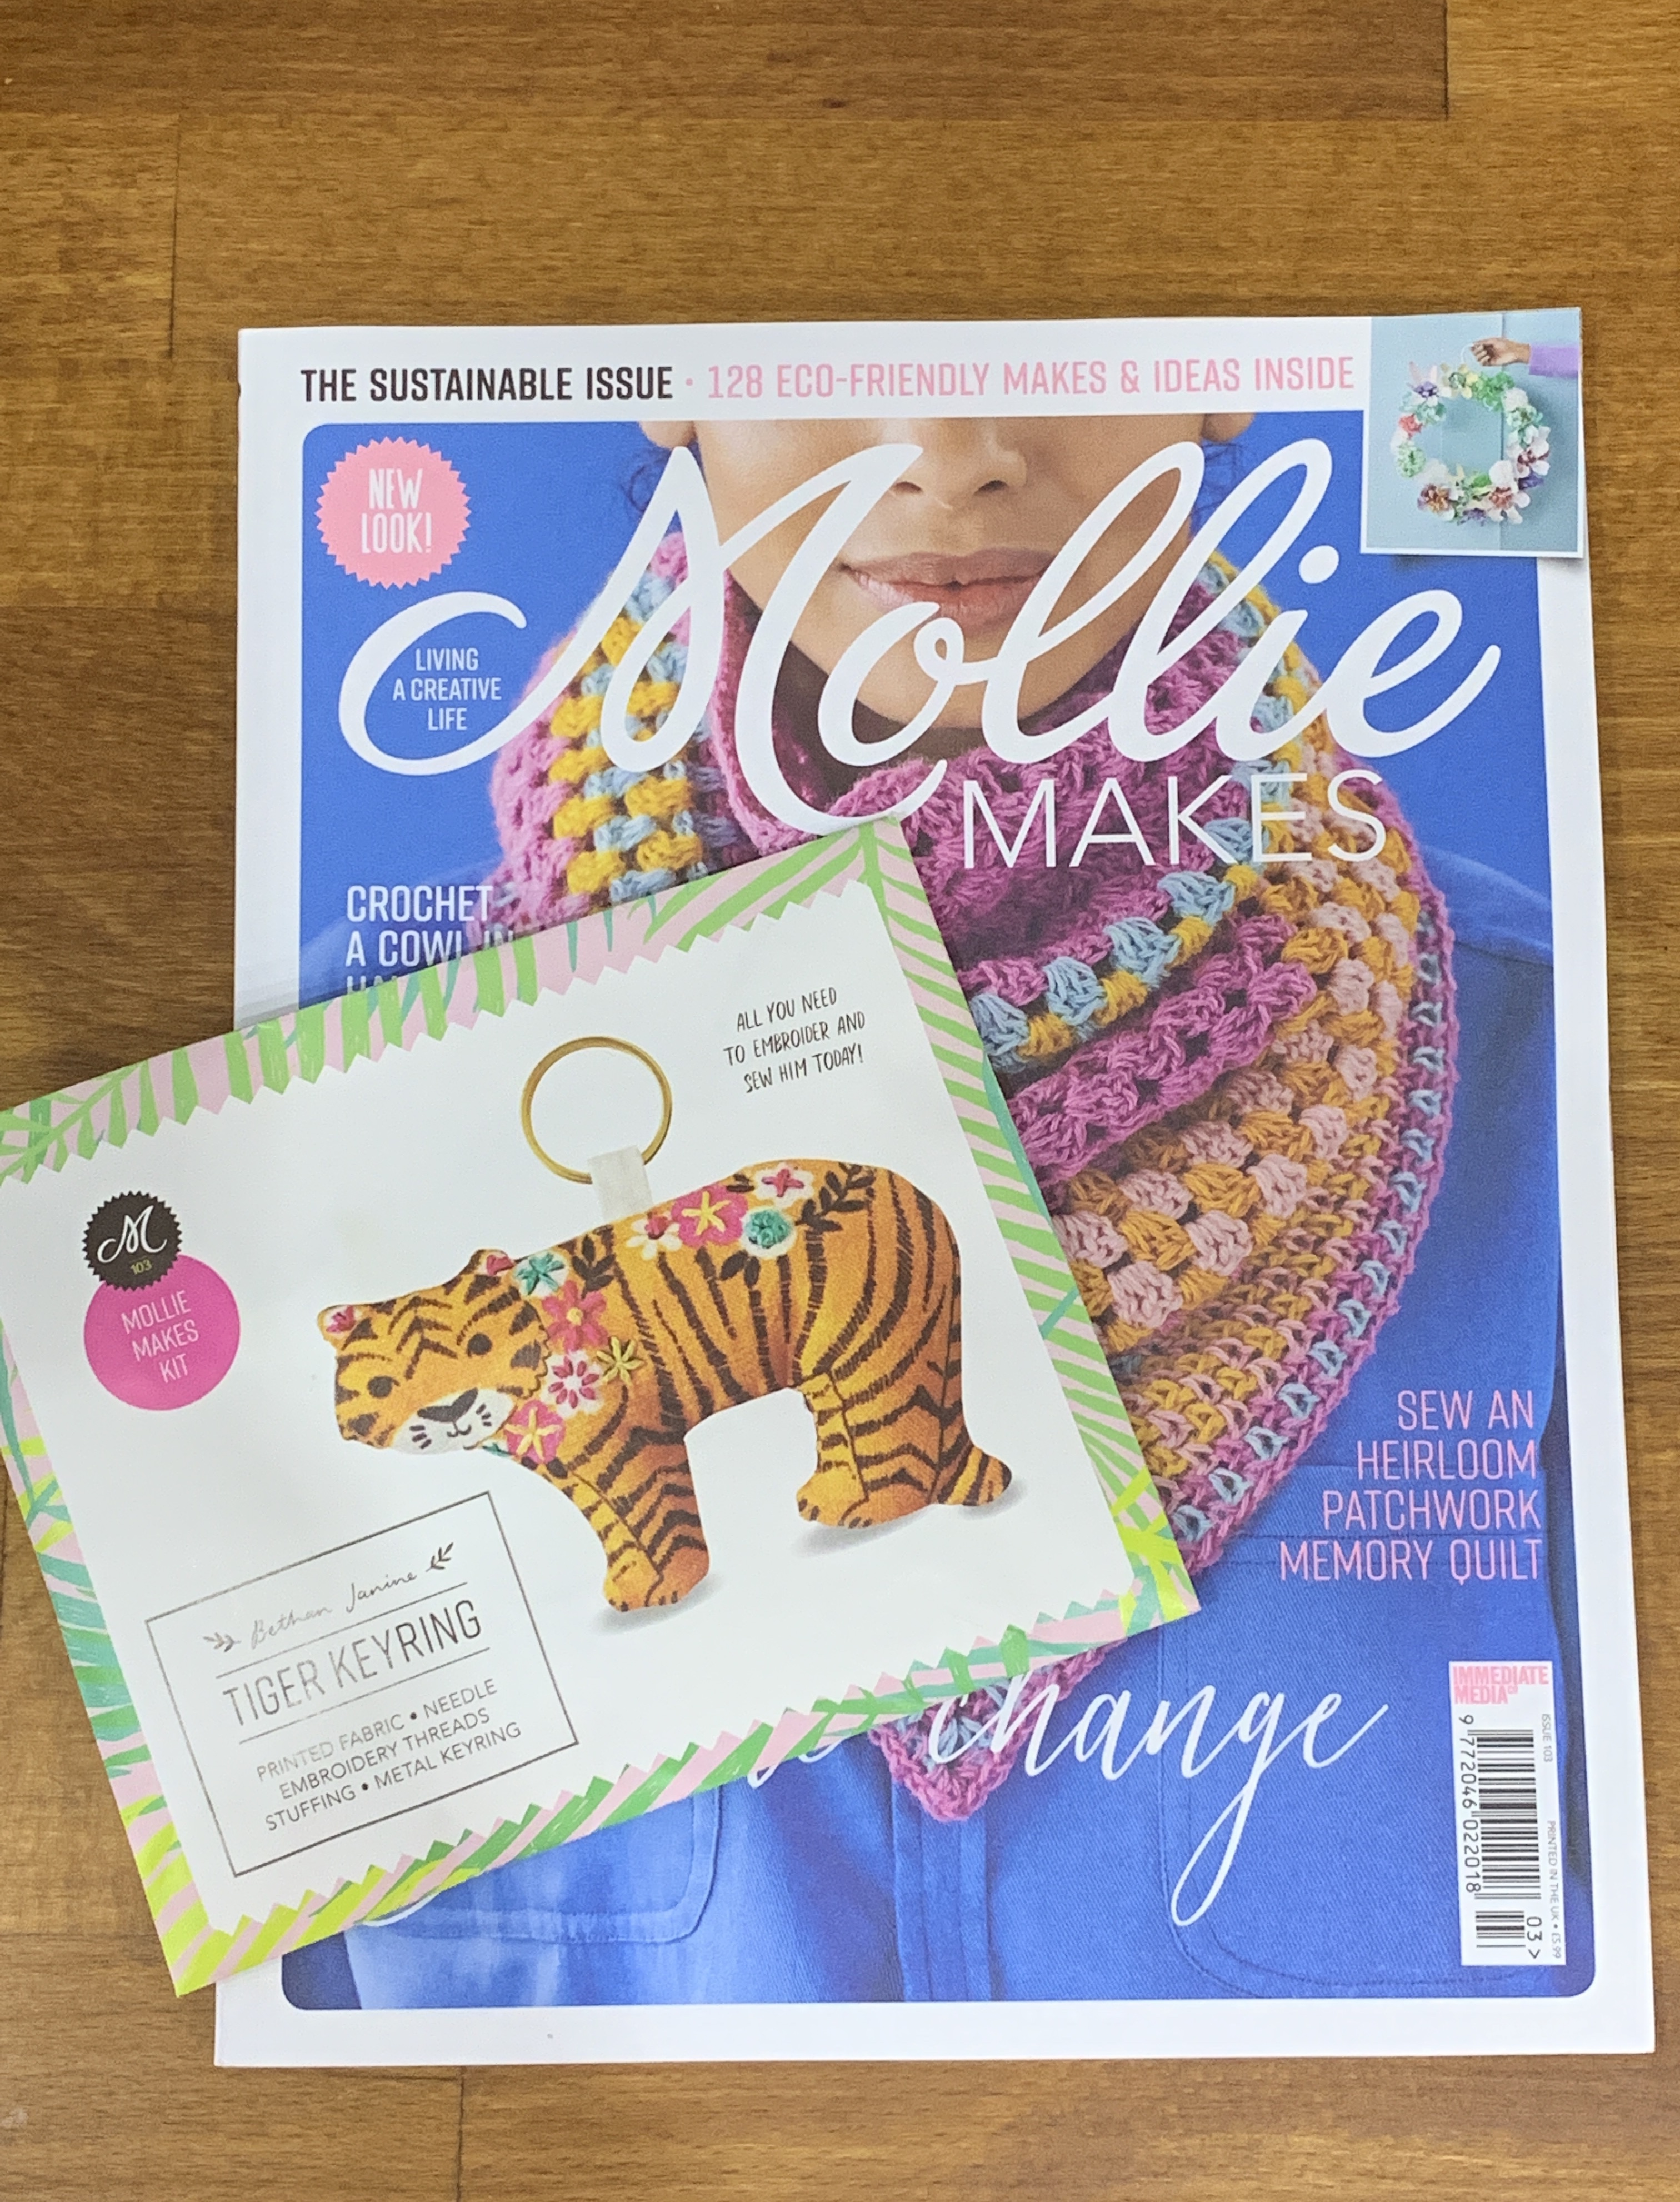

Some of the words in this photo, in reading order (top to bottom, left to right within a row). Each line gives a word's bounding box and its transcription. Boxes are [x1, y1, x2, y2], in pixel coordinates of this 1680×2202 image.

[301, 369, 356, 402] THE
[370, 367, 572, 401] SUSTAINABLE
[586, 366, 673, 400] ISSUE
[707, 364, 763, 398] 128
[777, 362, 989, 398] ECO-FRIENDLY
[1003, 359, 1106, 396] MAKES
[1121, 358, 1140, 393] &
[1154, 357, 1240, 392] IDEAS
[1254, 356, 1354, 390] INSIDE
[369, 468, 423, 509] NEW
[362, 512, 432, 553] LOOK!
[338, 438, 1502, 833] Mollie
[416, 648, 478, 671] LIVING
[393, 679, 406, 700] A
[411, 678, 501, 700] CREATIVE
[428, 708, 467, 730] LIFE
[963, 769, 1386, 870] MAKES
[347, 885, 494, 922] CROCHET
[345, 930, 366, 967] A
[737, 1010, 763, 1032] ALL
[767, 999, 795, 1023] YOU
[802, 987, 837, 1013] NEED
[723, 1045, 745, 1066] TO
[753, 1021, 830, 1058] EMBROIDER
[837, 1011, 865, 1036] AND
[744, 1067, 772, 1093] SEW
[779, 1058, 807, 1082] HIM
[812, 1043, 863, 1073] TODAY!
[97, 1205, 167, 1263] M
[129, 1259, 152, 1275] 103
[121, 1290, 191, 1334] MOLLIE
[132, 1319, 199, 1362] MAKES
[159, 1353, 188, 1384] KIT
[1398, 1390, 1473, 1431] SEW
[1488, 1390, 1533, 1429] AN
[1357, 1439, 1536, 1480] HEIRLOOM
[1323, 1489, 1541, 1530] PATCHWORK
[1280, 1539, 1433, 1581] MEMORY
[1449, 1538, 1542, 1585] QUILT
[251, 1605, 333, 1650] Bethan
[346, 1571, 417, 1613] Janine
[223, 1659, 326, 1726] TIGER
[328, 1599, 482, 1688] KEYRING
[1453, 1666, 1549, 1685] IMMEDIATE
[256, 1741, 334, 1781] PRINTED
[339, 1714, 405, 1751] FABRIC
[423, 1678, 498, 1719] NEEDLE
[1458, 1714, 1474, 1725] 9
[1542, 1714, 1552, 1741] ISSUE
[279, 1742, 398, 1799] EMBROIDERY
[403, 1707, 491, 1751] THREADS
[1459, 1737, 1477, 1809] 772046
[1544, 1746, 1553, 1762] 103
[266, 1784, 357, 1831] STUFFING
[374, 1755, 437, 1790] METAL
[441, 1721, 522, 1764] KEYRING
[1463, 1819, 1481, 1893] 022018
[1547, 1820, 1557, 1866] PRINTED
[1549, 1870, 1557, 1880] IN
[1550, 1883, 1559, 1904] THE
[1551, 1907, 1559, 1921] UK
[1552, 1933, 1561, 1959] £5.99
